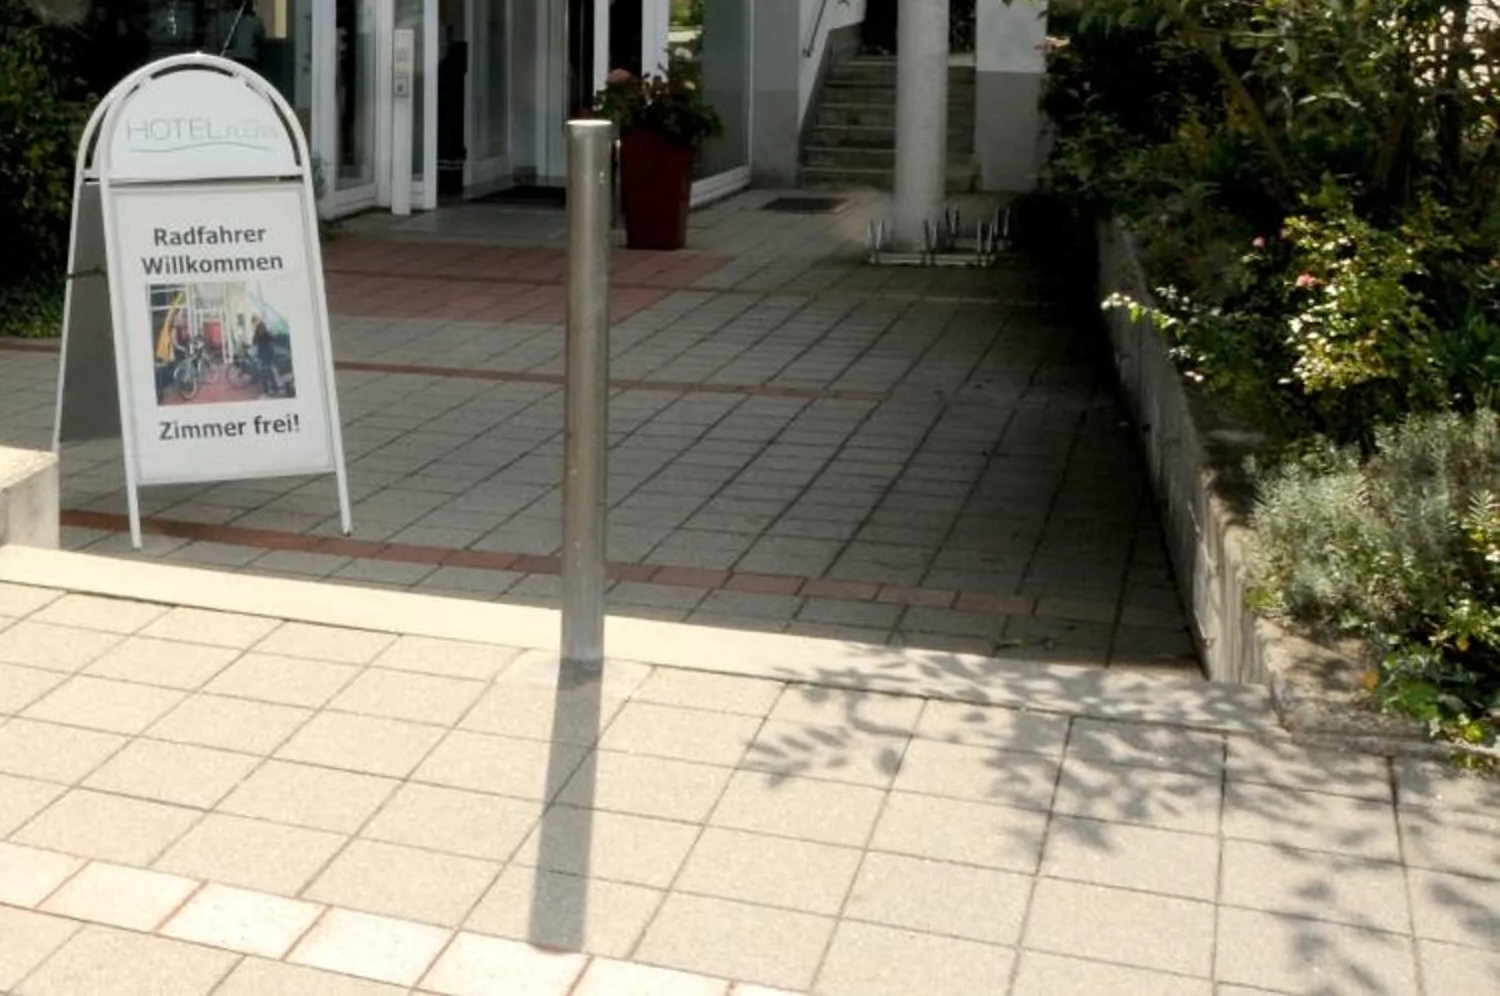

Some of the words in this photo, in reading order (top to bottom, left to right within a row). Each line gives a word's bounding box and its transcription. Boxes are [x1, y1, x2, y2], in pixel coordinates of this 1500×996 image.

[126, 117, 222, 142] HOTEL
[153, 225, 267, 246] Radfahrer
[141, 254, 284, 276] Willkommen
[158, 420, 247, 441] Zimmer
[253, 413, 300, 435] frei!
